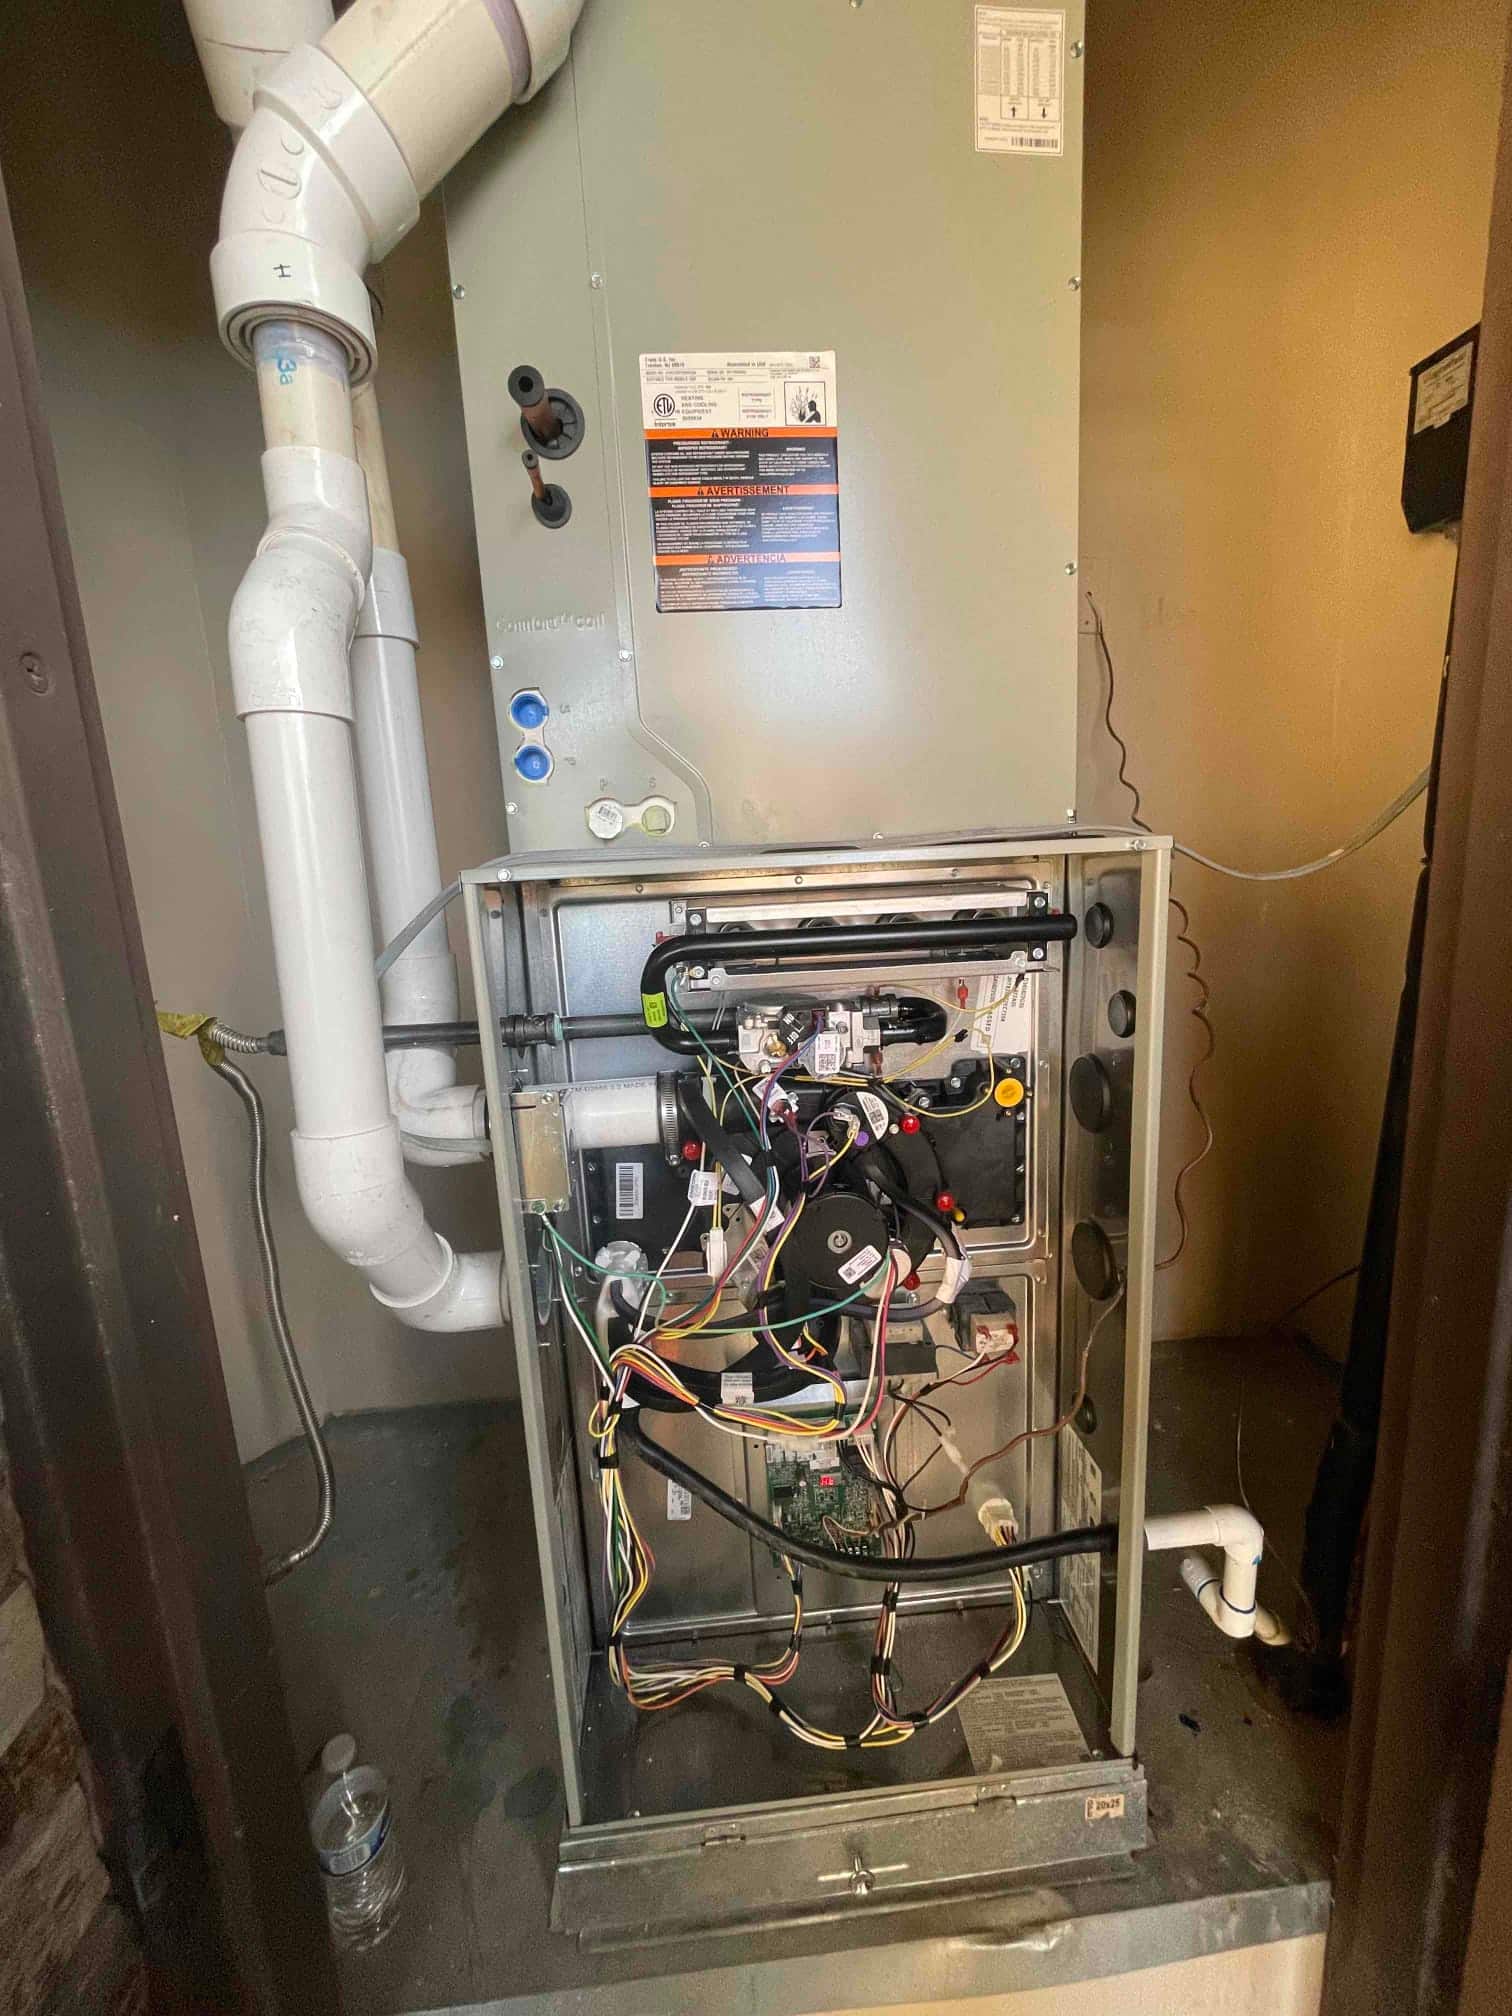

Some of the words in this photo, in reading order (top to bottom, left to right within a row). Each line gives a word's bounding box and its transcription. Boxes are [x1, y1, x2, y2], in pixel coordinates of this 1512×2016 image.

[720, 428, 769, 438] WARNING
[706, 485, 790, 496] AVERTISSEMENT
[717, 554, 786, 564] ADVERTENCIA
